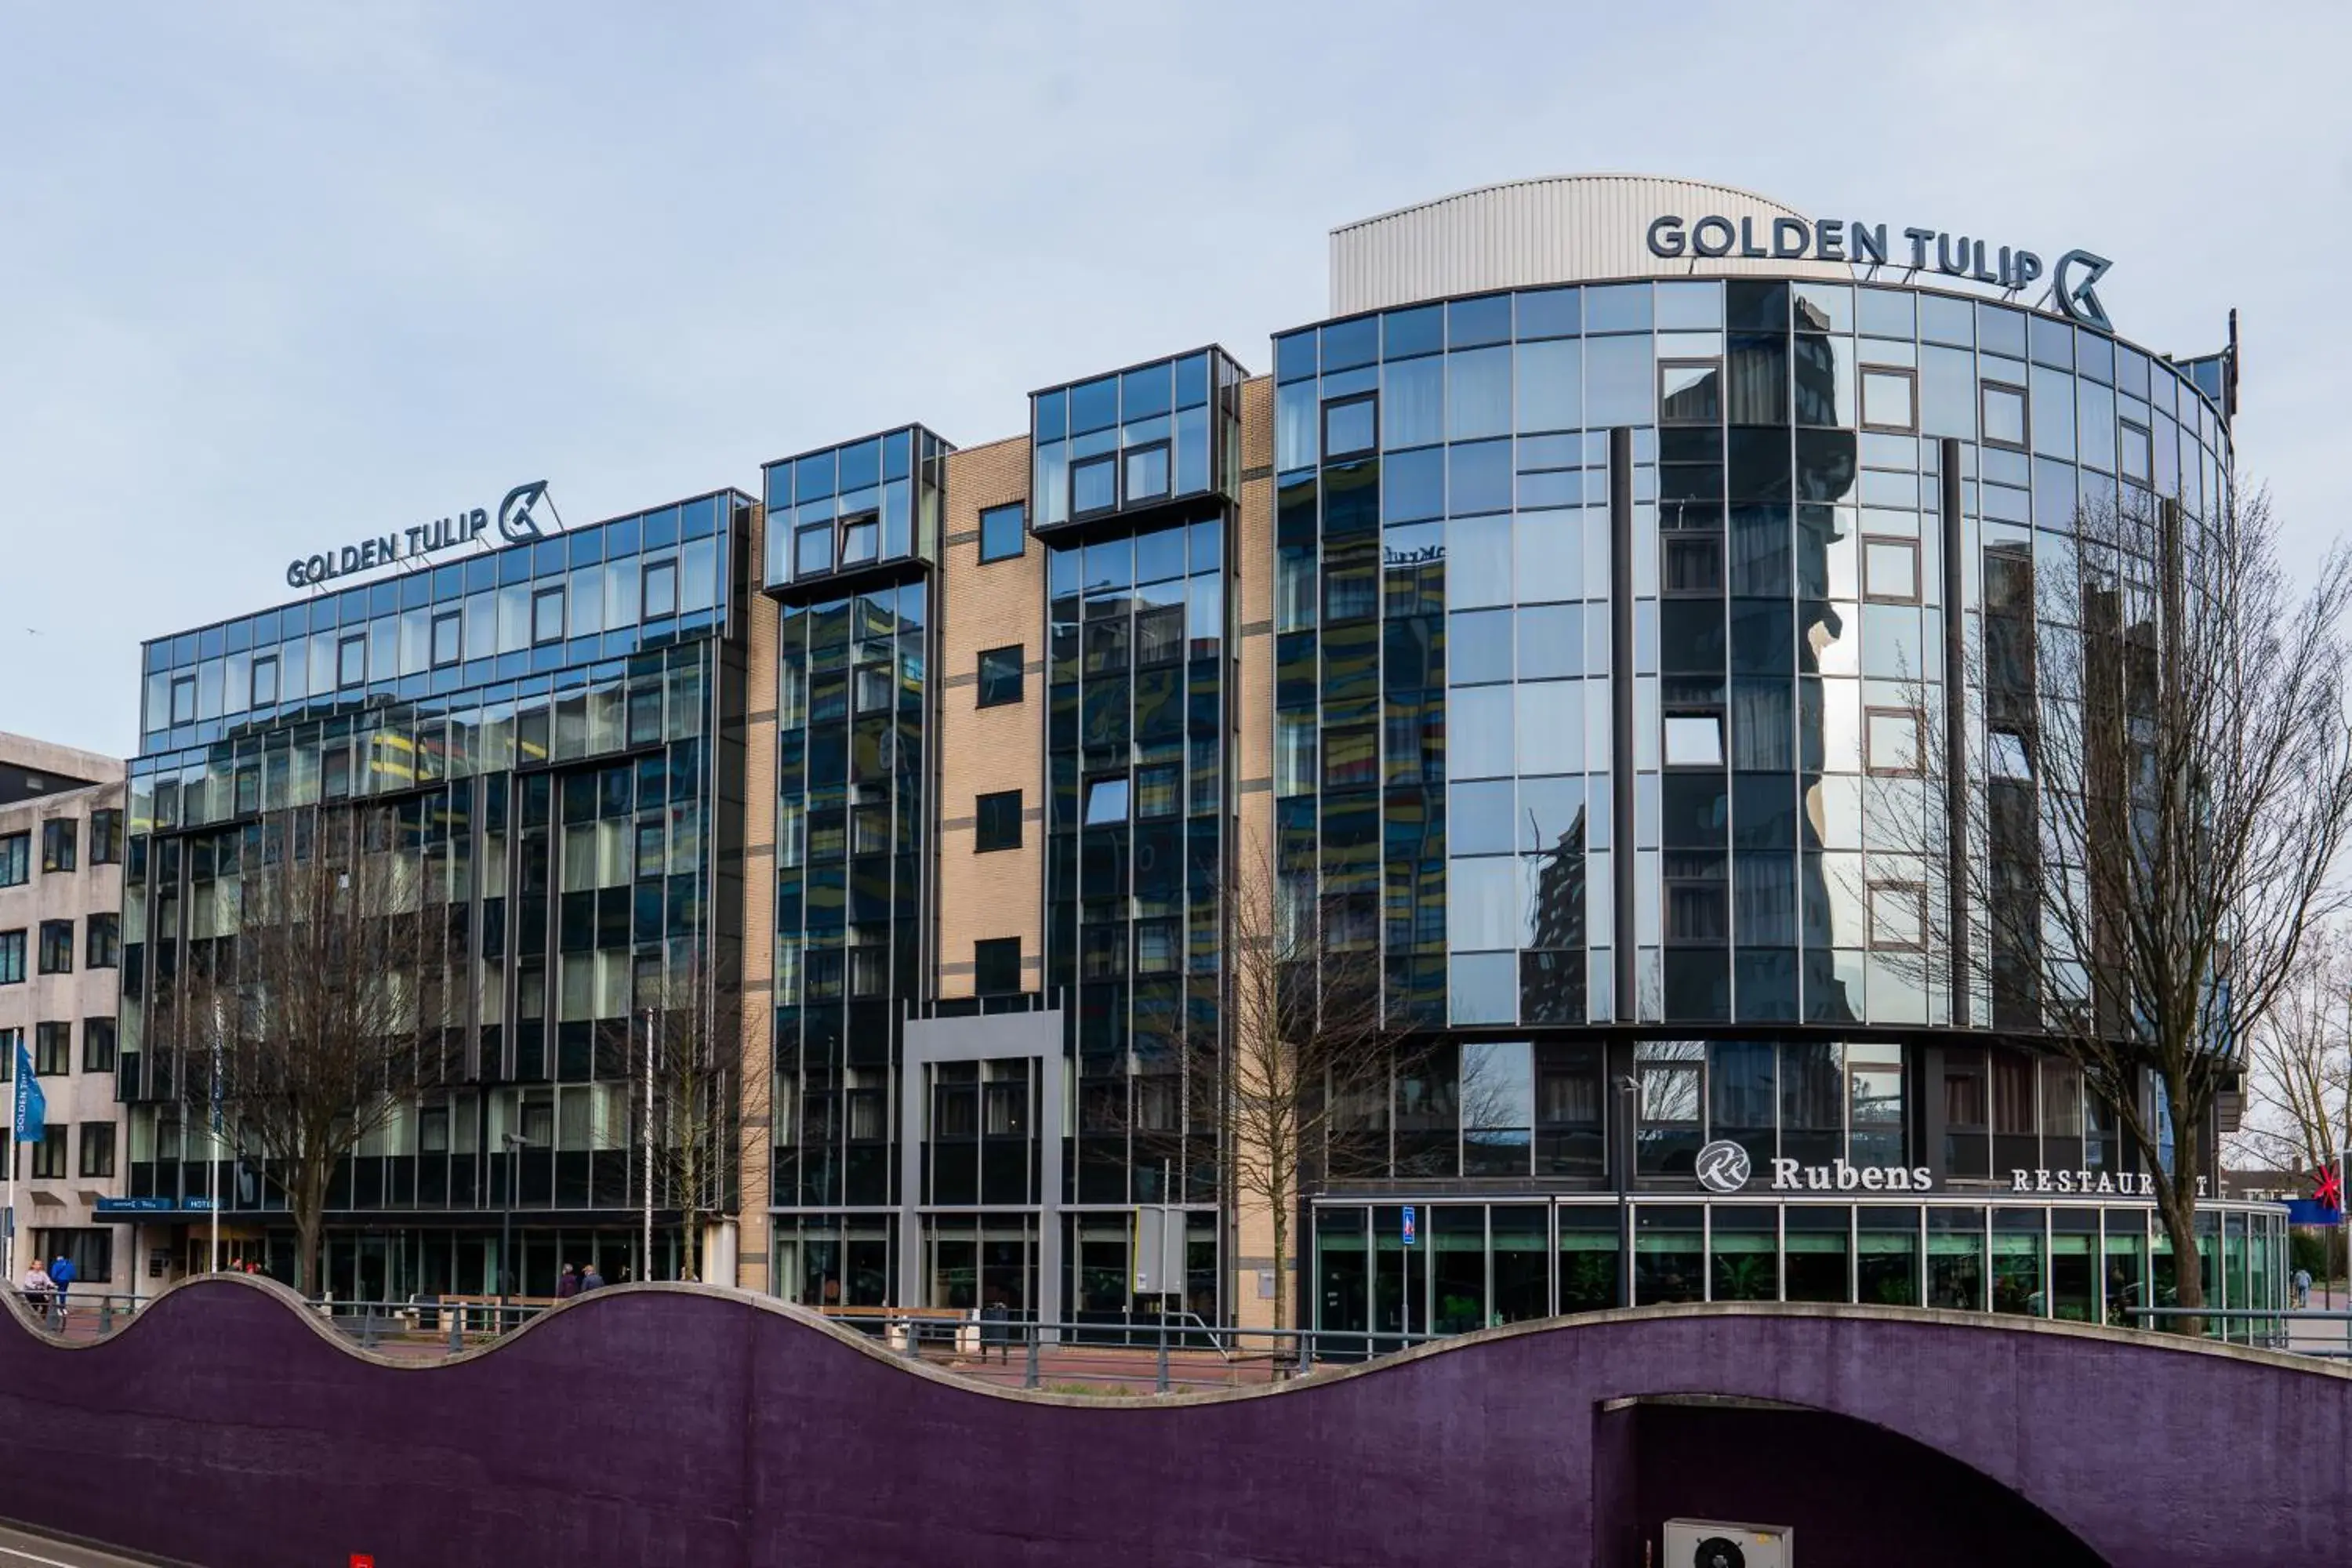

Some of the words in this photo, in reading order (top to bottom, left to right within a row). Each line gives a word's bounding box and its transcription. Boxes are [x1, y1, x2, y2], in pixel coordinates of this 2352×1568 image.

[1646, 215, 1887, 265] GOLDEN
[1904, 227, 2043, 290] TULIP
[286, 532, 398, 589] GOLDEN
[405, 507, 489, 556] TULIP
[1769, 1158, 1933, 1191] Rubens
[2011, 1169, 2207, 1196] RESTAURT
